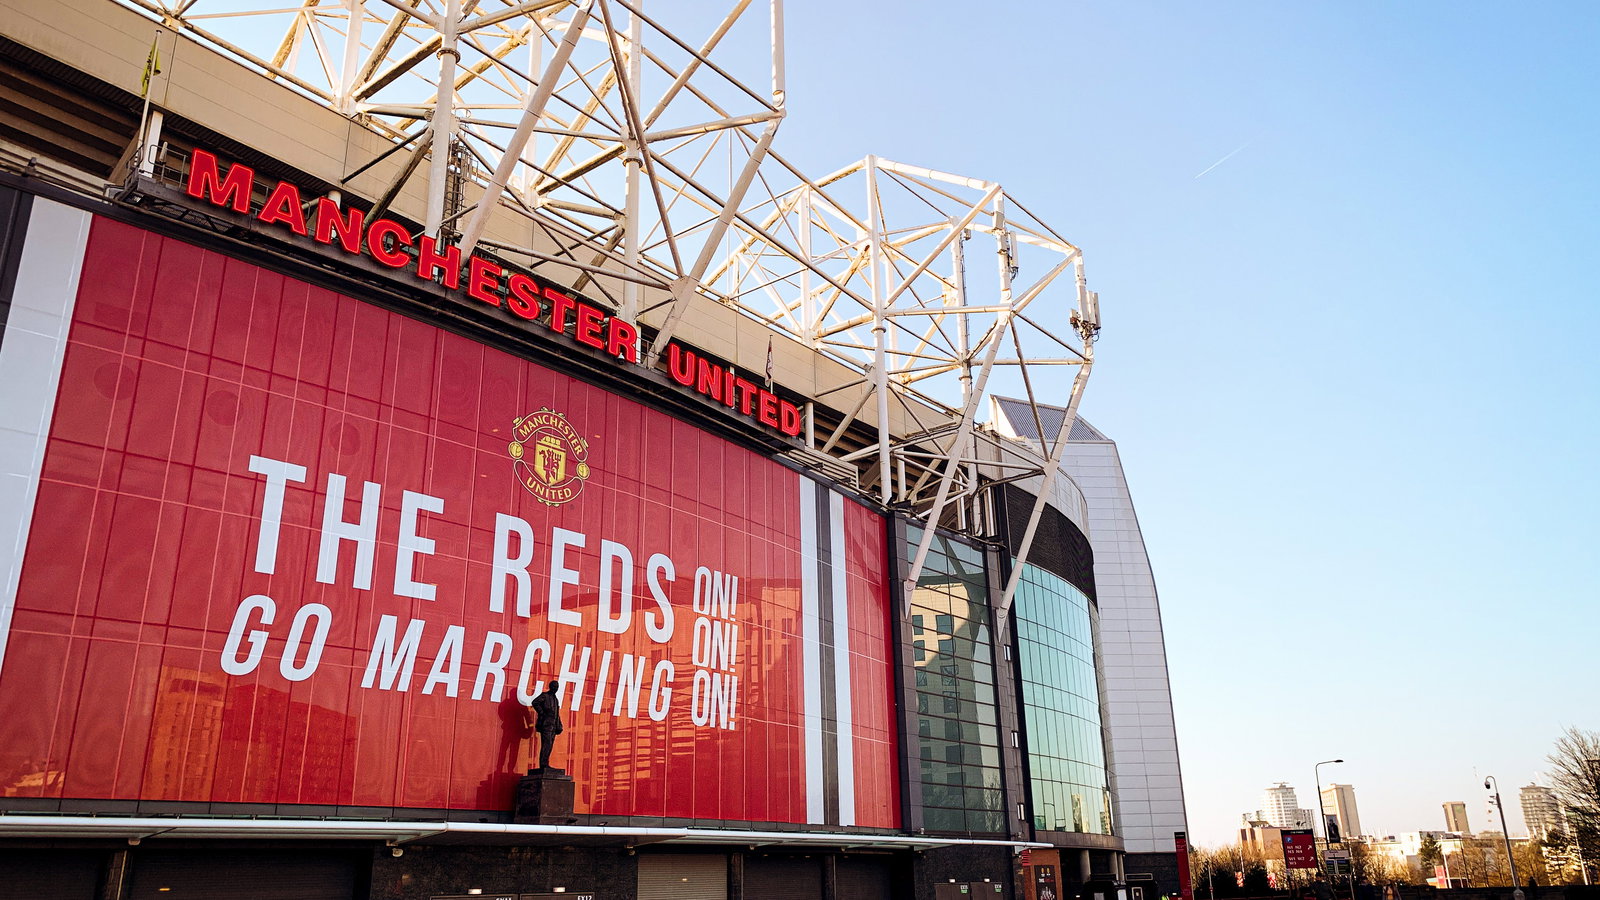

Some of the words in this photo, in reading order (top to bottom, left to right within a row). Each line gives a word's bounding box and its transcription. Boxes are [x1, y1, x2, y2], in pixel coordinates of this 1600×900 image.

[186, 147, 638, 364] MANCHESTER
[667, 342, 802, 437] UNITED
[518, 414, 583, 455] MANCHESTER
[526, 476, 572, 500] UNITED
[248, 454, 445, 601] THE
[488, 511, 676, 644] REDS
[693, 566, 739, 621] ON!
[219, 594, 333, 682] GO
[360, 614, 675, 722] MARCHING
[691, 616, 739, 672] ON!
[690, 668, 738, 731] ON!
